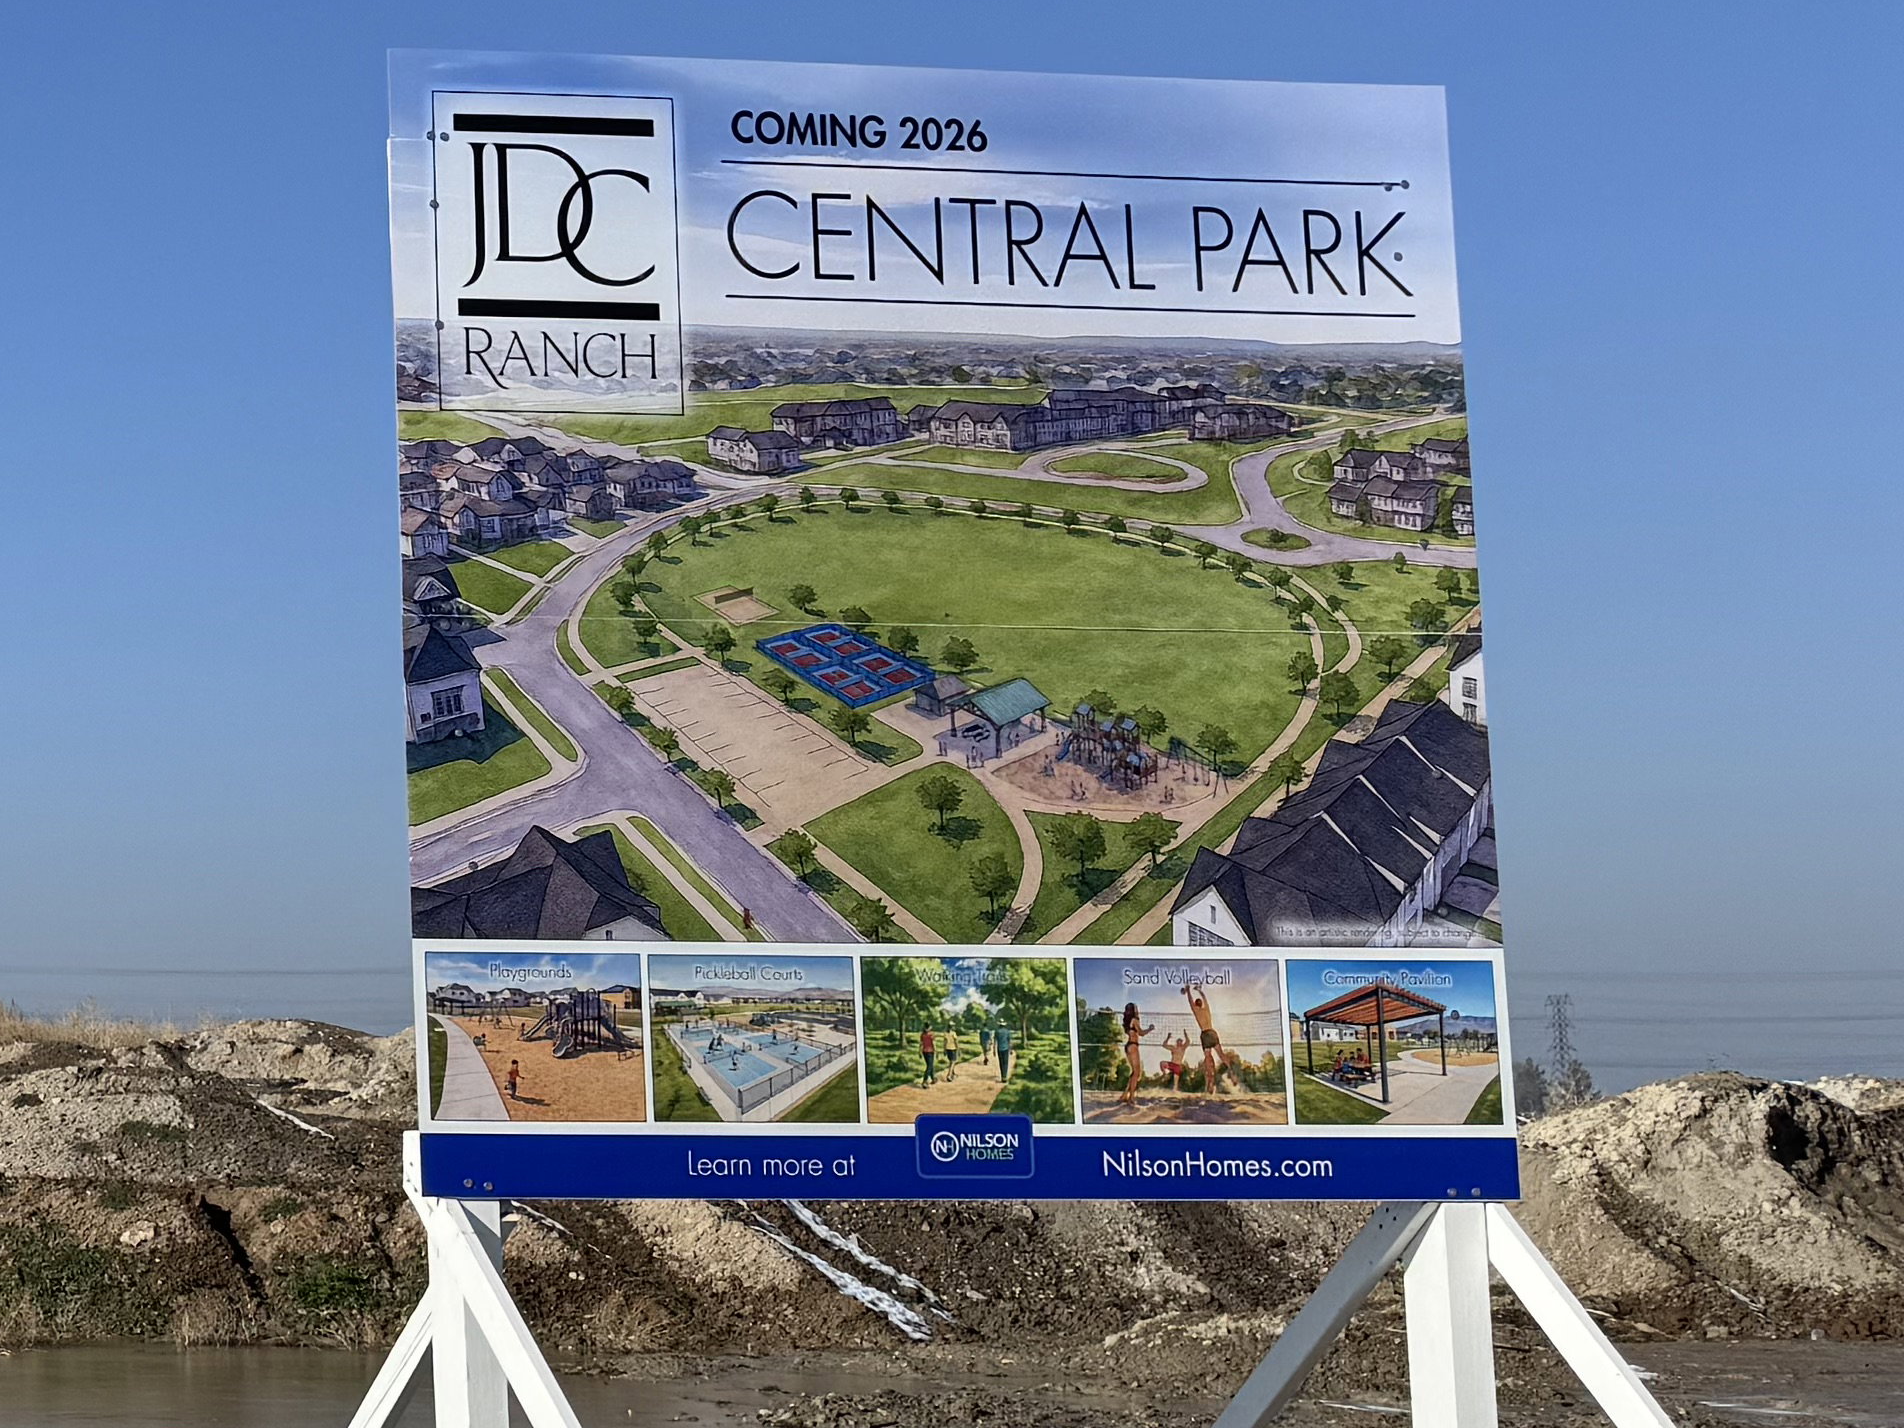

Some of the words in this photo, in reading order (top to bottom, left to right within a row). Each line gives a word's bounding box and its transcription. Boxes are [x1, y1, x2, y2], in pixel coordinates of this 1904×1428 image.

[731, 110, 887, 149] COMING
[899, 116, 988, 153] 2026
[462, 142, 655, 287] JDC
[726, 189, 1156, 290] CENTRAL
[1192, 205, 1414, 298] PARK
[463, 326, 658, 390] RANCH
[489, 962, 572, 983] Playgrounds
[694, 964, 756, 981] Pickleball
[760, 966, 803, 981] Courts
[914, 967, 972, 987] Walking
[974, 968, 1010, 983] Trails
[1123, 968, 1160, 985] Sand
[1164, 968, 1230, 987] Volleyball
[1323, 970, 1397, 987] Community
[1400, 970, 1451, 986] Pavilion
[960, 1133, 1019, 1148] NILSON
[688, 1150, 752, 1176] Learn
[763, 1157, 824, 1176] more
[832, 1154, 857, 1177] at
[966, 1147, 1014, 1160] HOMES
[1102, 1148, 1333, 1178] NilsonHomes.com
